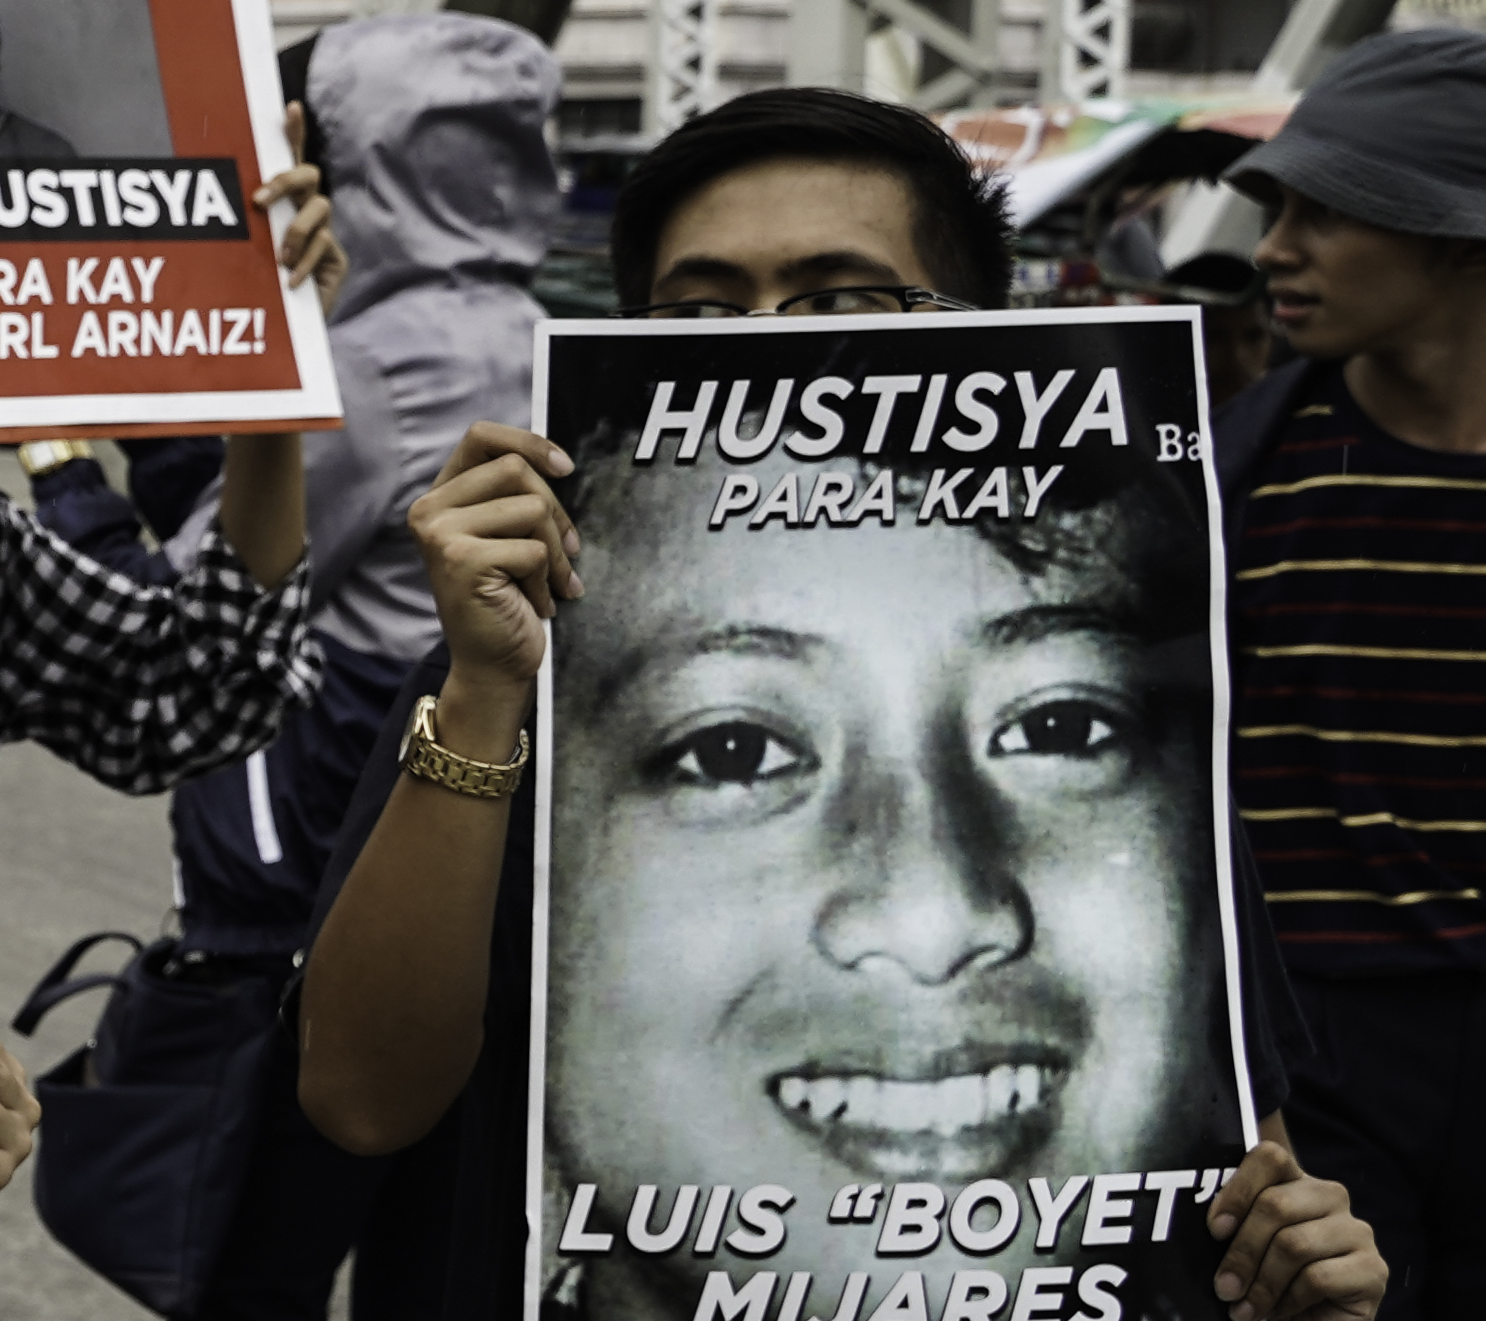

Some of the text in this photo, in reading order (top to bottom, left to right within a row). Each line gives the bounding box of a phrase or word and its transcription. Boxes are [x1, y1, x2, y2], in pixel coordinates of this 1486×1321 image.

[66, 256, 165, 304] KAY
[71, 308, 266, 358] ARNAIZ!
[634, 367, 1130, 461] HUSTISYA
[709, 465, 1064, 528] PARA KAY
[557, 1182, 795, 1255] LUIS
